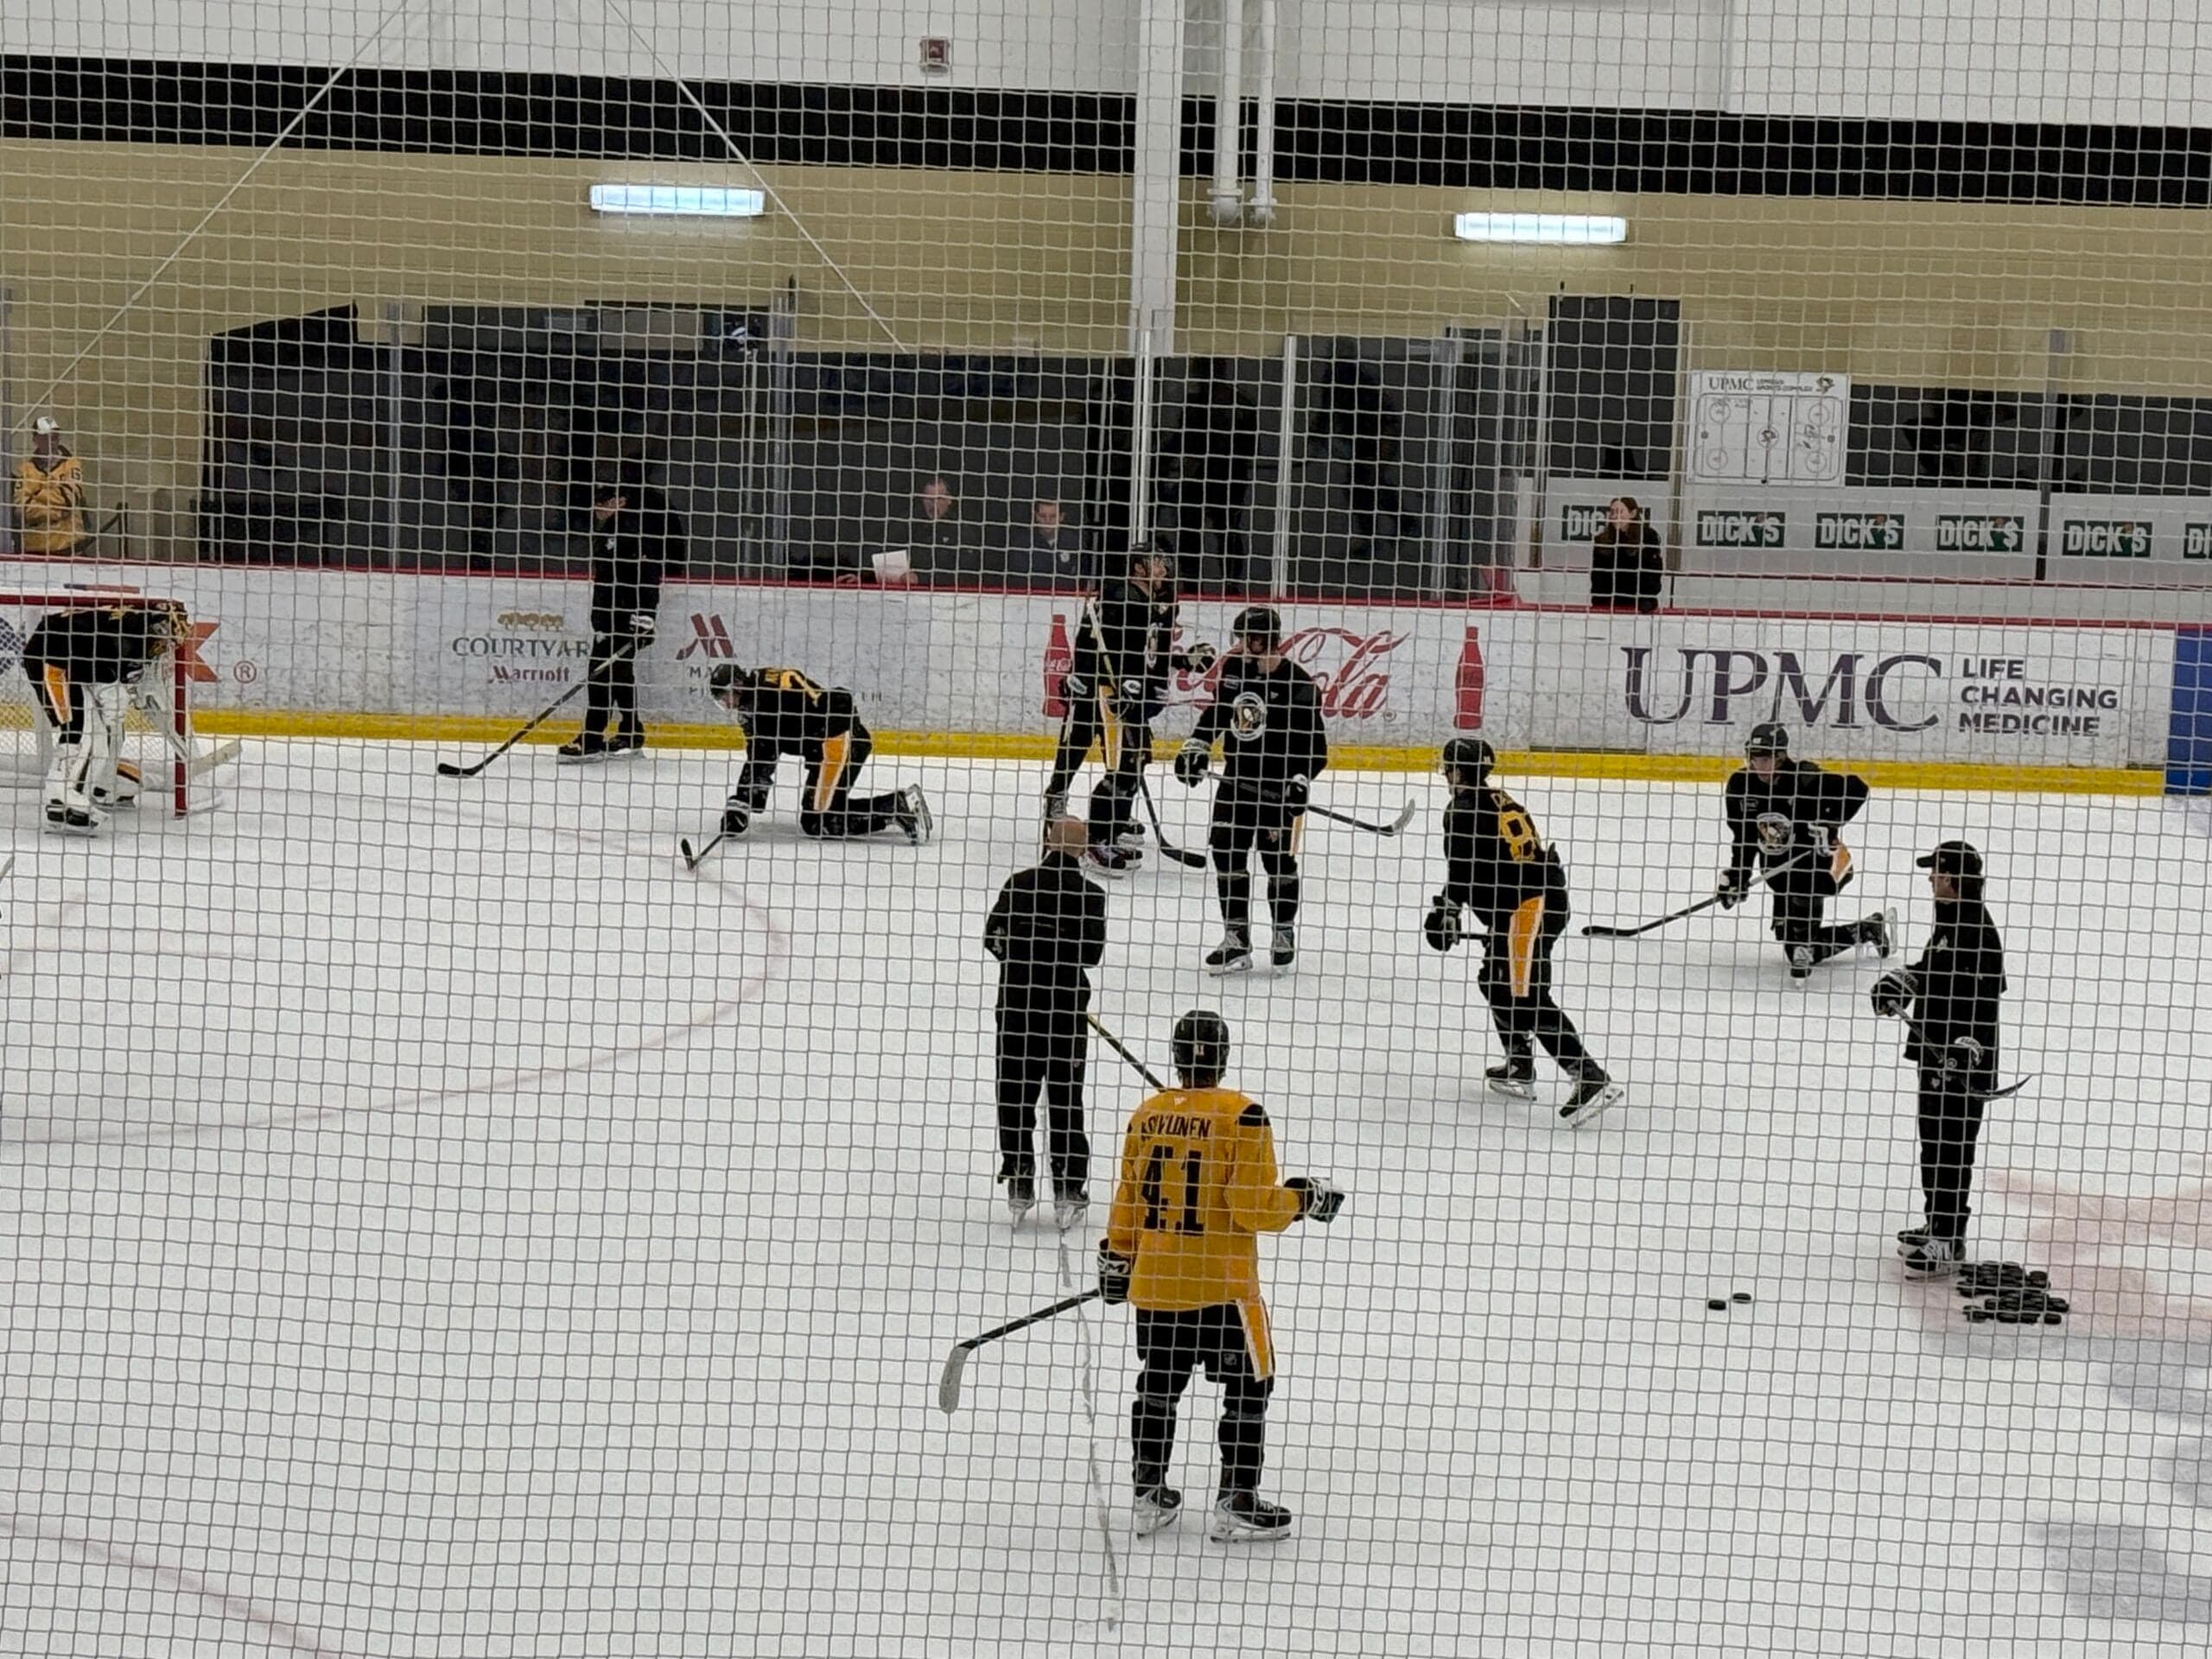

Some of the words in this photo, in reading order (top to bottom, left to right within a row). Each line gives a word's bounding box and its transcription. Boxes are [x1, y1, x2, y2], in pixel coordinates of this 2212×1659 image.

[1708, 377, 1754, 391] UPMC
[452, 636, 591, 659] COURTYAR
[487, 664, 570, 684] Marriott
[1962, 658, 2024, 681] LIFE
[1620, 645, 1942, 732] UPMC
[1960, 684, 2119, 710] CHANGING
[1957, 711, 2101, 737] MEDICINE
[1141, 1145, 1205, 1236] 41
